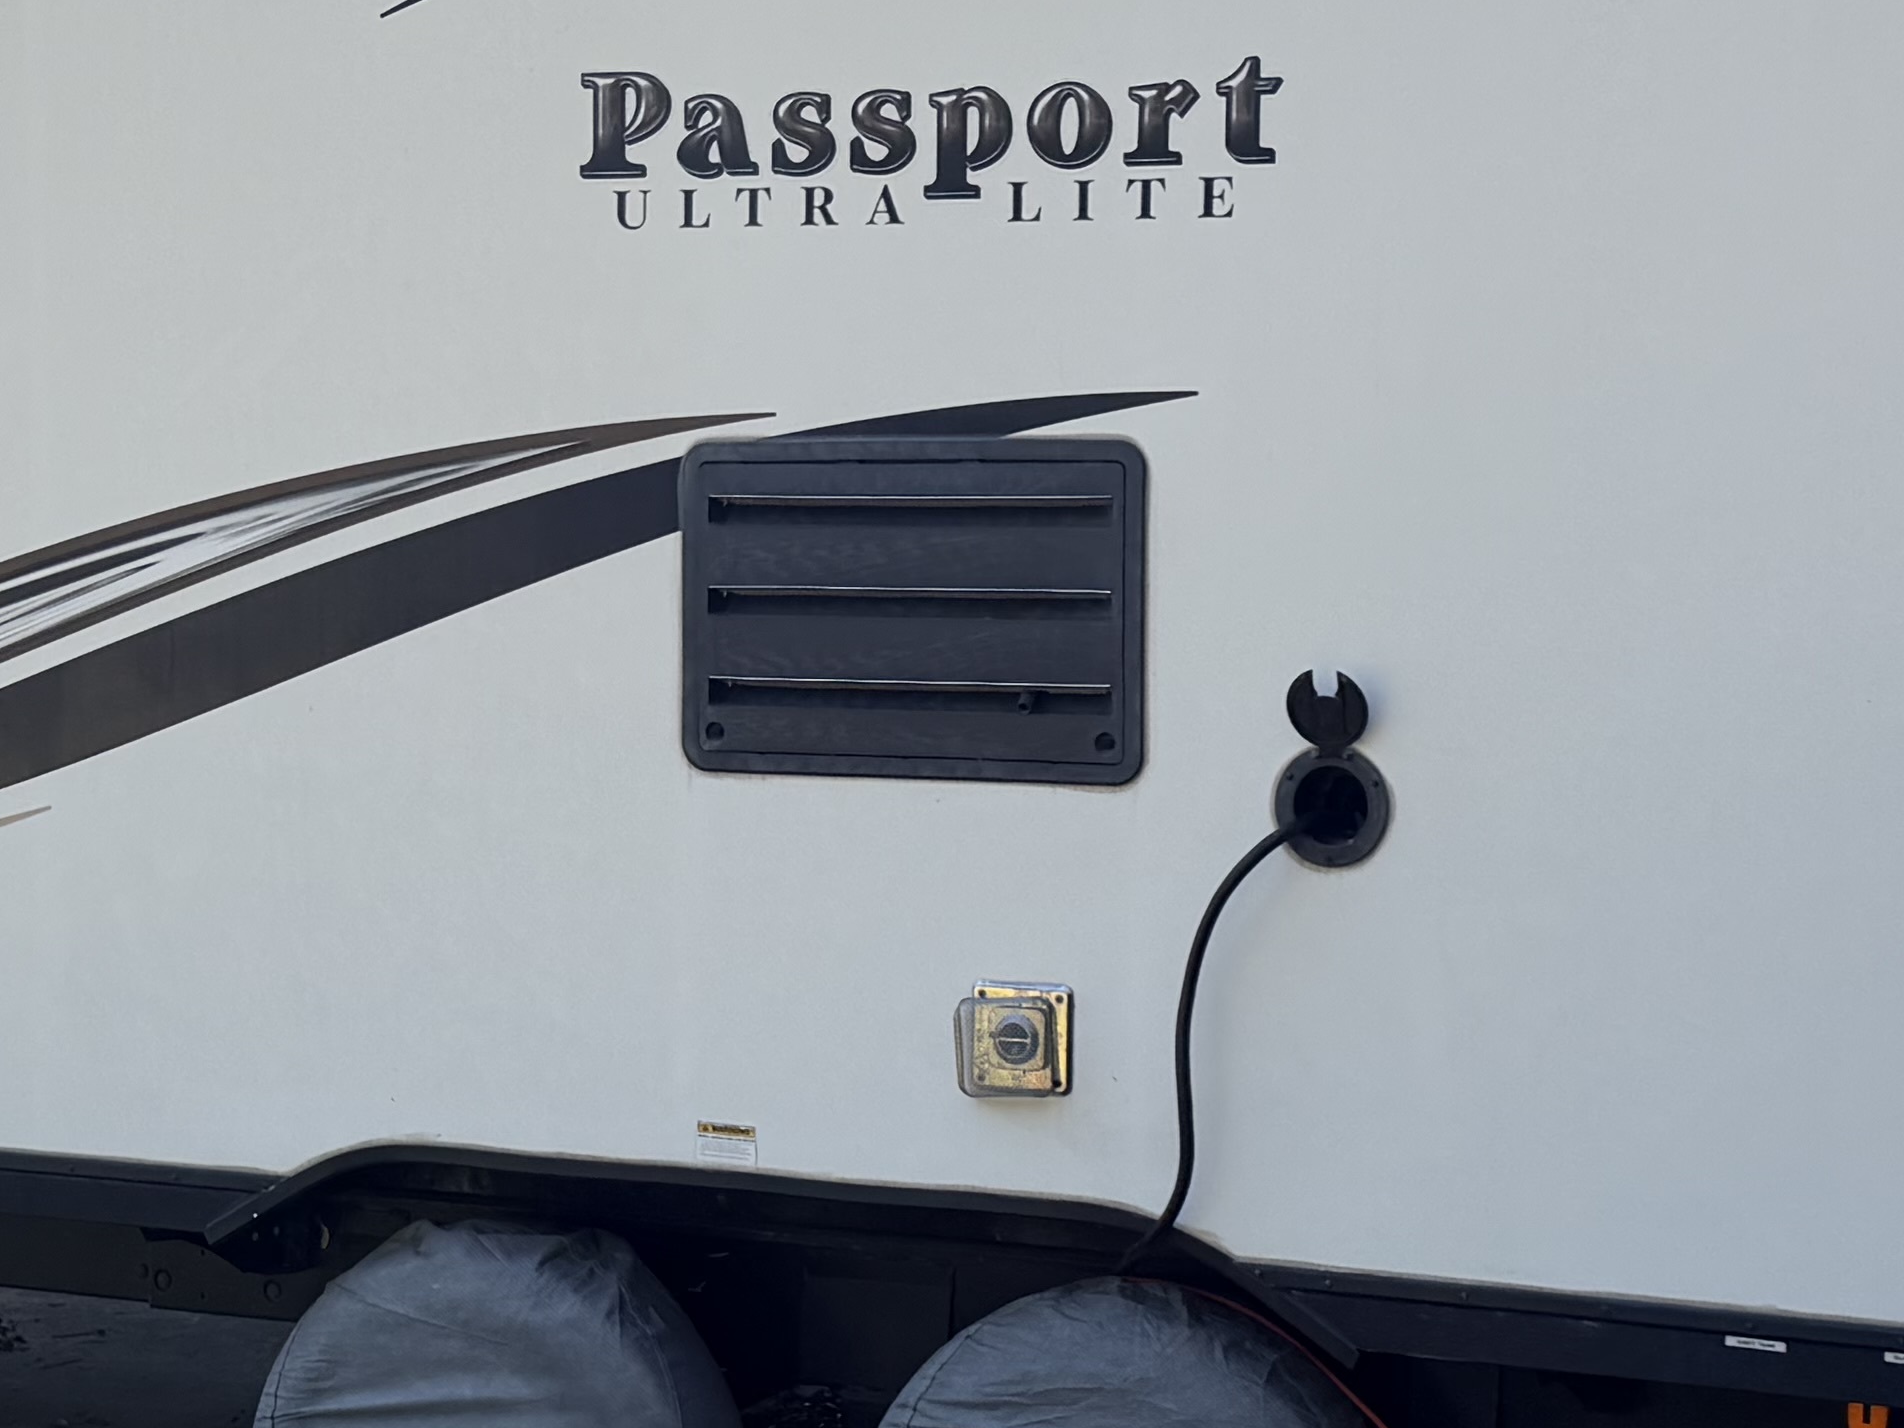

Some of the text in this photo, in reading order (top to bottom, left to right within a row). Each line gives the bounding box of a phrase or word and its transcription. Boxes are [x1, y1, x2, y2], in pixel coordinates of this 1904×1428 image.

[579, 55, 1284, 201] Passport
[612, 176, 1236, 230] ULTRA LITE
